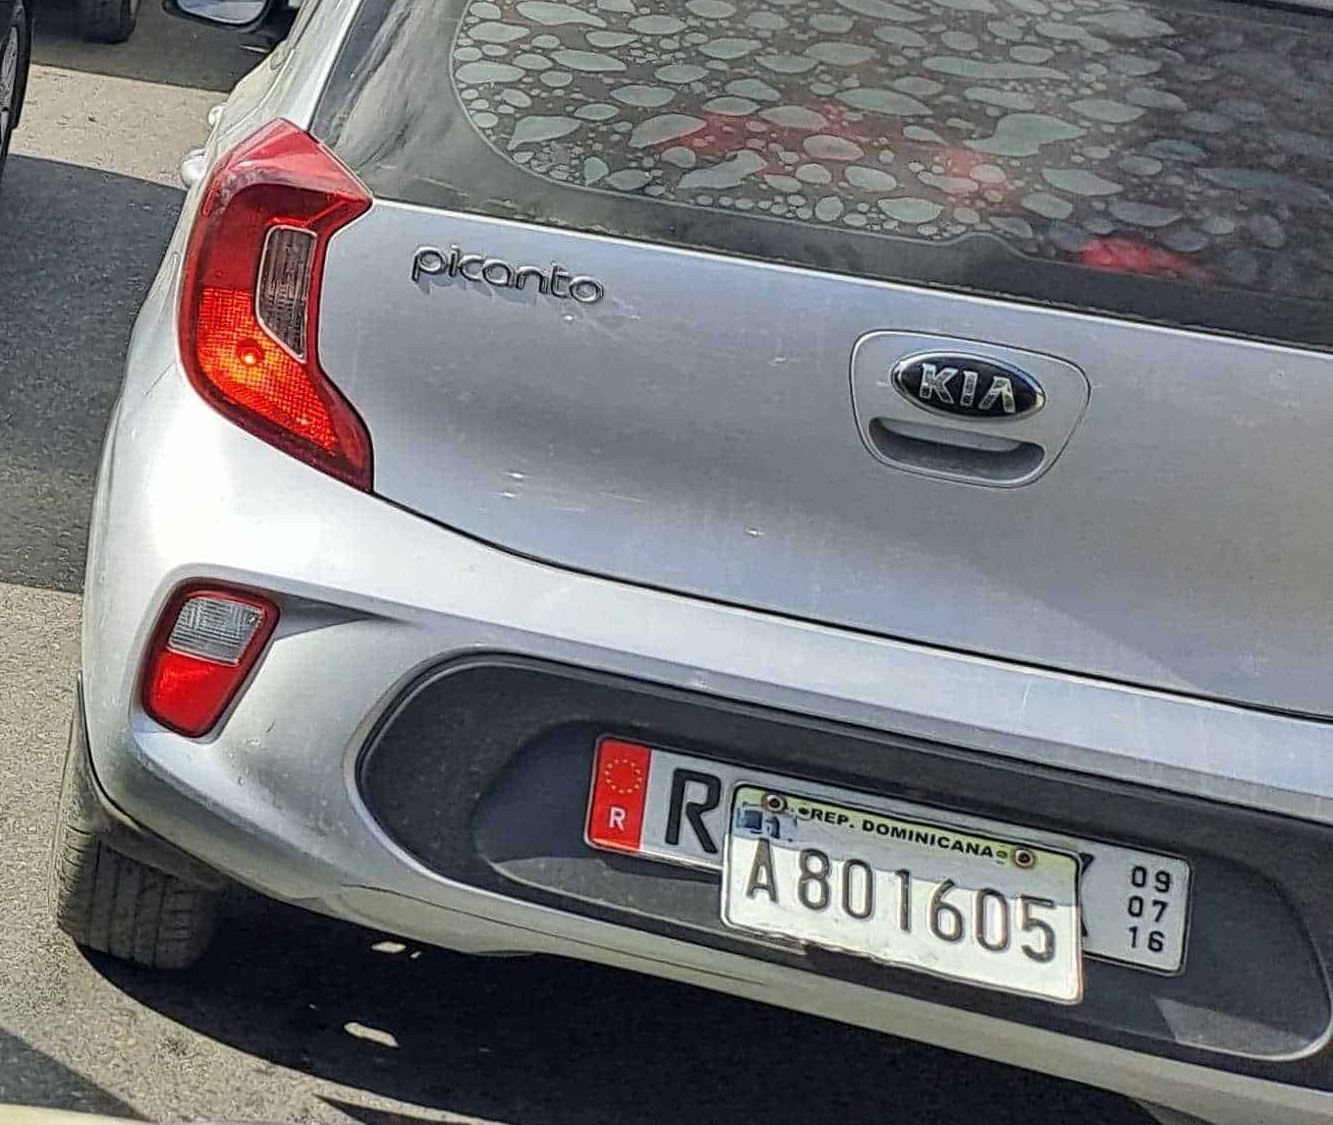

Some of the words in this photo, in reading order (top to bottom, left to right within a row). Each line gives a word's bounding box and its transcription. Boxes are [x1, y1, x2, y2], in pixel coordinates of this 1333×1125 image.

[411, 243, 605, 304] picanto
[919, 363, 1016, 413] KIA
[609, 806, 626, 830] R
[665, 767, 721, 854] R
[811, 808, 854, 828] REP.
[862, 820, 994, 858] DOMINICANA
[745, 838, 1055, 963] A801605
[1131, 866, 1171, 893] 09
[1128, 895, 1168, 923] 07
[1127, 926, 1165, 952] 16
